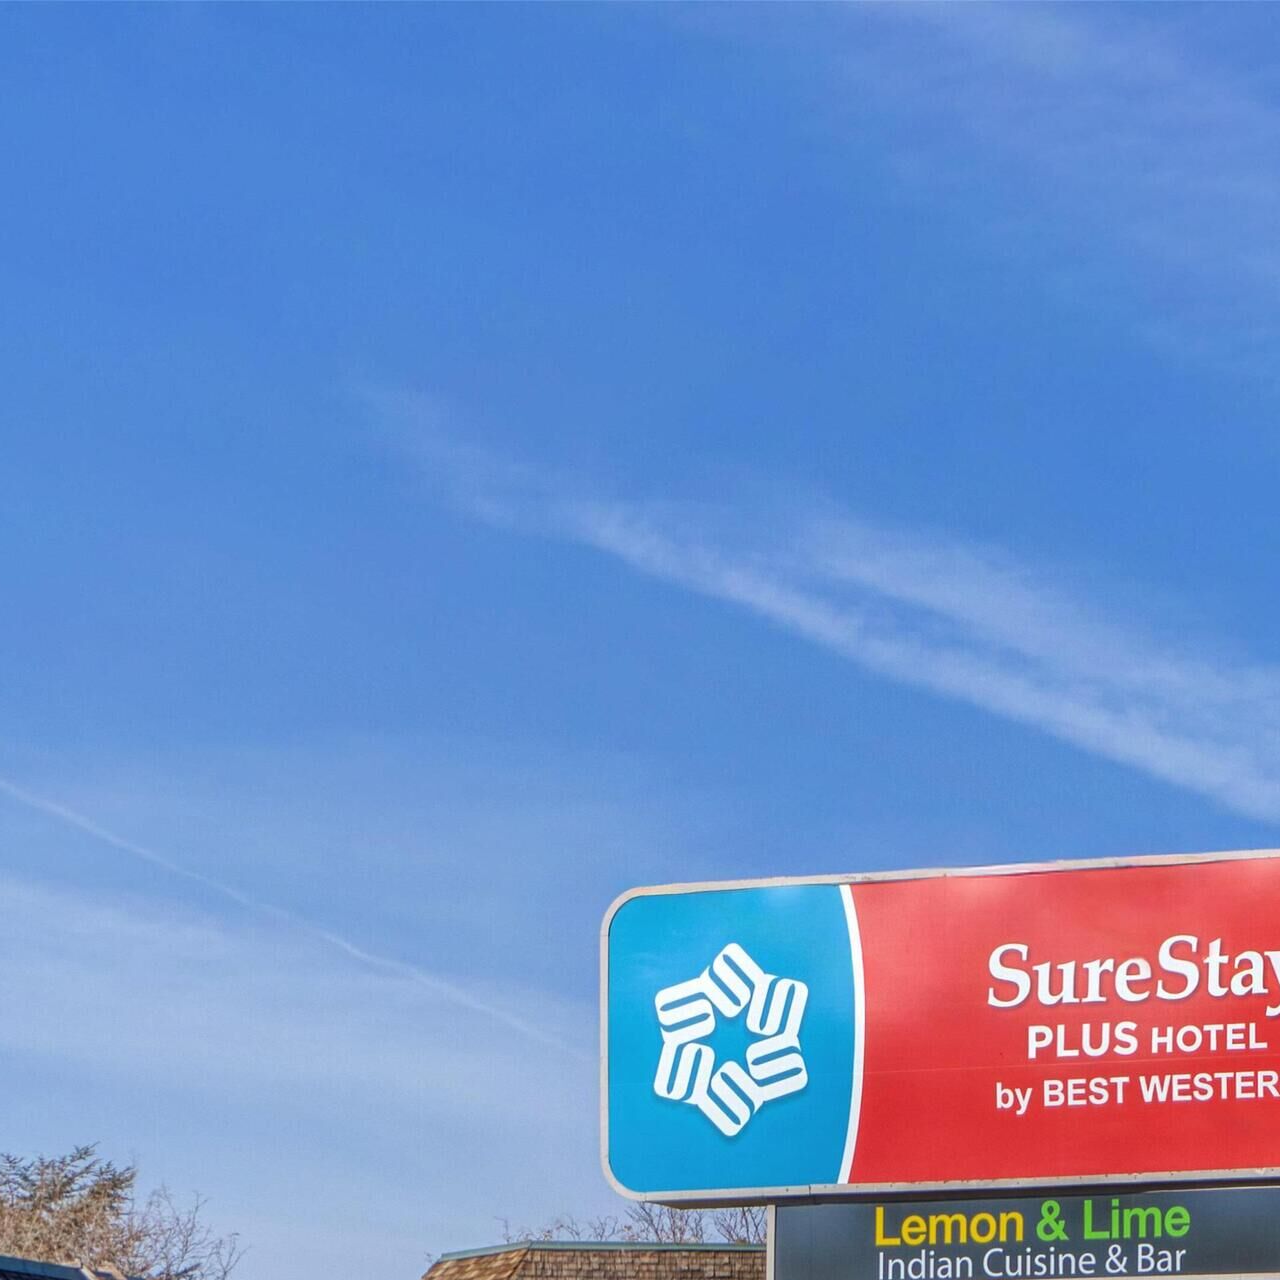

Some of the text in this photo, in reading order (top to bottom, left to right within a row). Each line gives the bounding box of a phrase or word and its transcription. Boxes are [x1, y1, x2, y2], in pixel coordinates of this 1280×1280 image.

[1027, 1021, 1268, 1059] PLUS HOTEL
[995, 1082, 1033, 1115] by
[1043, 1076, 1130, 1107] BEST
[875, 1199, 1191, 1246] Lemon & Lime
[879, 1244, 1187, 1280] Indian Cuisine & Bar
